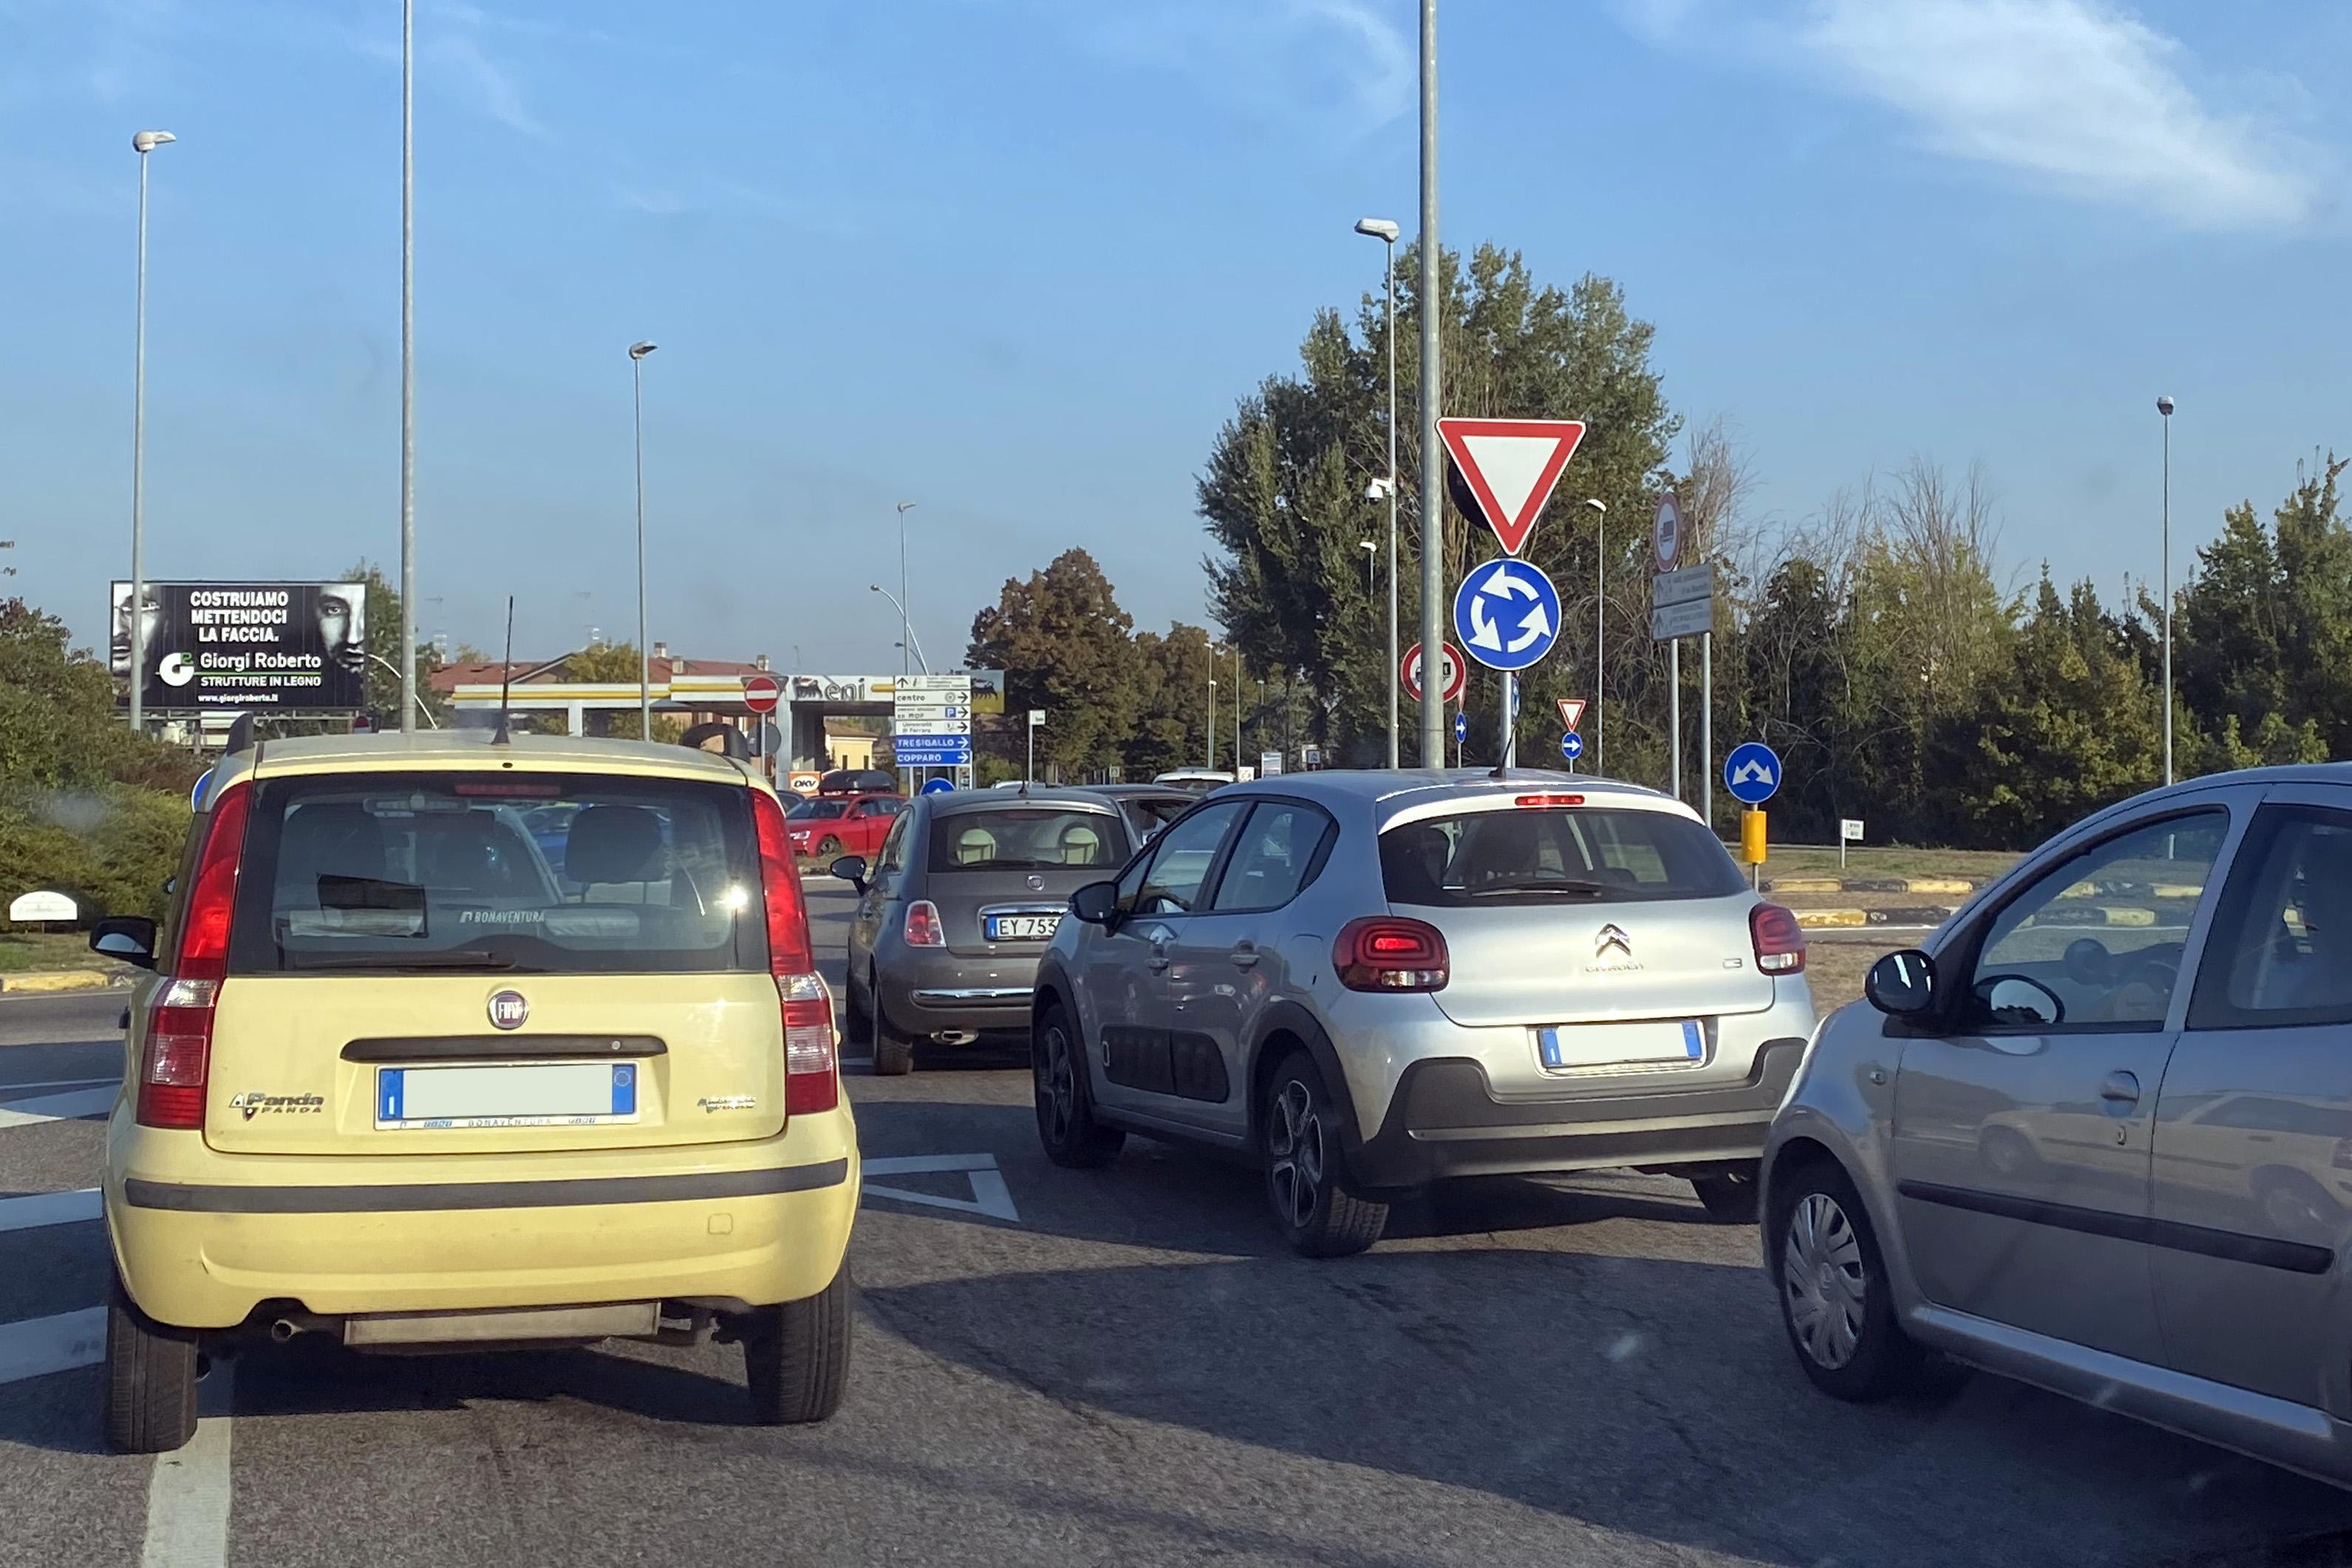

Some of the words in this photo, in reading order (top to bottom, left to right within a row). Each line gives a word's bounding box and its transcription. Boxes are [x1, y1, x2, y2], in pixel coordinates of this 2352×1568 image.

[190, 591, 289, 607] COSTRUIAMO
[191, 609, 287, 624] METTENDOCI
[199, 627, 218, 642] LA
[221, 627, 279, 642] FACCIA.
[200, 652, 250, 672] Giorgi
[255, 652, 321, 668] Roberto
[200, 676, 267, 686] STRUTTURE
[269, 676, 282, 686] IN
[284, 676, 321, 686] LEGNO
[825, 678, 865, 701] eni
[197, 694, 279, 703] www.giorgiroberto.it
[897, 693, 925, 701] centro
[898, 739, 955, 747] TRESIGALLO
[897, 754, 941, 762] COPPARO
[474, 910, 545, 923] BONAVENTURA
[999, 919, 1019, 935] EY
[497, 1001, 522, 1019] FIAT
[246, 1093, 324, 1106] Panda
